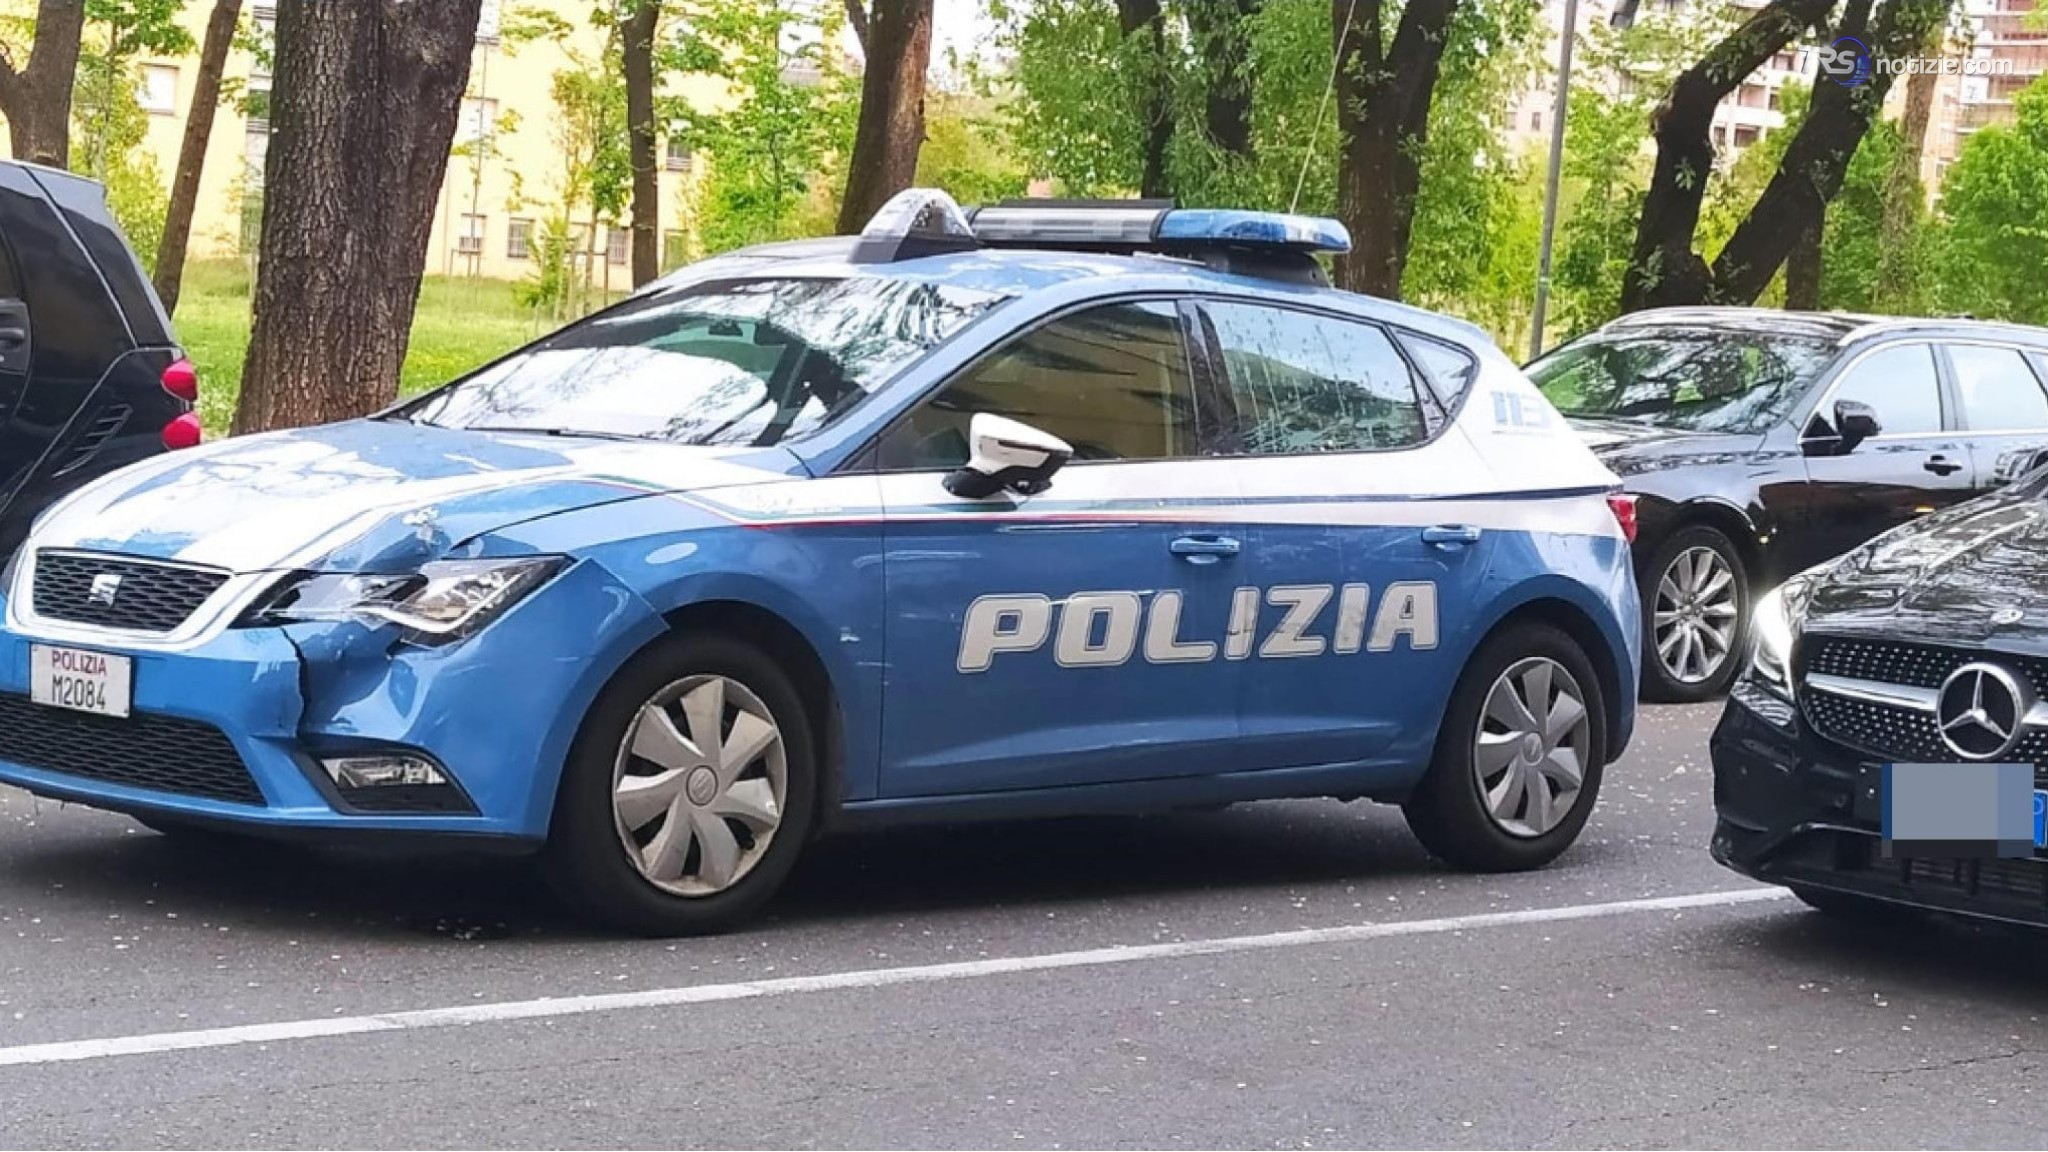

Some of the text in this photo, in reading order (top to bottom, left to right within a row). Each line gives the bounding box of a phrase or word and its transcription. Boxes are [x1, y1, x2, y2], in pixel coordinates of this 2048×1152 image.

[956, 581, 1439, 674] POLIZIA
[52, 650, 107, 676] POLIZIA
[52, 675, 106, 710] M2084
